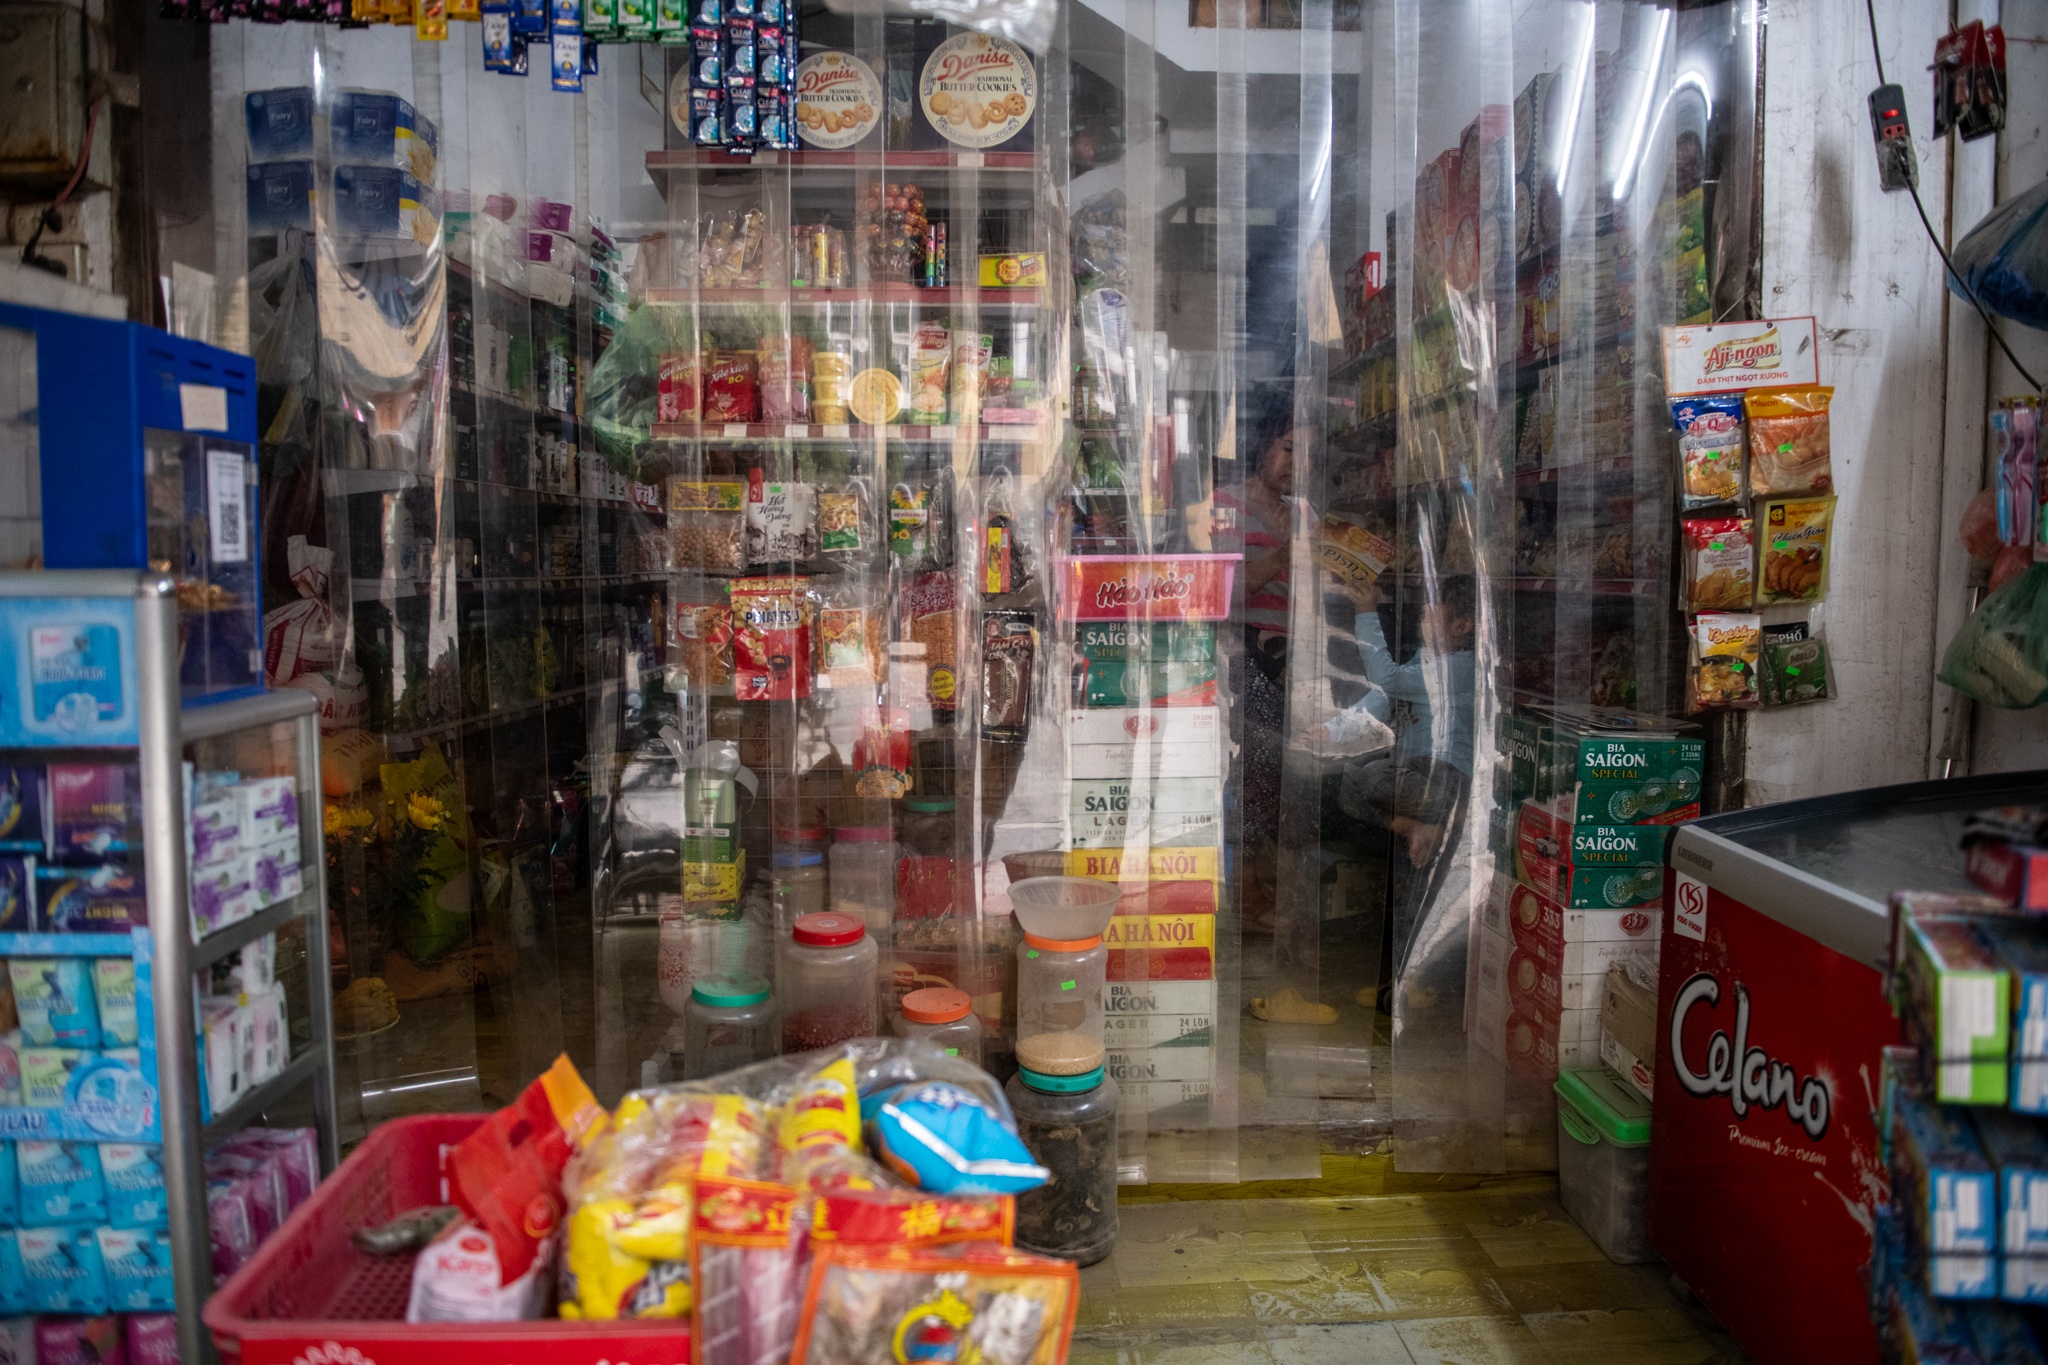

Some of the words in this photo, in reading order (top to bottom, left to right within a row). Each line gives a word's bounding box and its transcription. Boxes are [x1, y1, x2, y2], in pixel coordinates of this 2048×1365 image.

[484, 21, 507, 31] Dove
[730, 27, 752, 35] CLEAR
[555, 40, 579, 51] Dove
[936, 48, 1014, 81] Danisa
[798, 65, 862, 93] Danisa
[940, 82, 975, 92] BUTTER
[976, 81, 1017, 92] COOKIES
[801, 94, 831, 102] BUTTER
[831, 94, 865, 102] COOKIES
[271, 112, 292, 121] Fairy
[356, 117, 378, 126] Fairy
[267, 185, 290, 195] Fairy
[358, 189, 381, 199] Fairy
[1704, 342, 1776, 370] Aji-ngon
[672, 370, 693, 382] HEO
[728, 374, 744, 385] BÒ
[1717, 376, 1734, 385] THỊT
[1736, 374, 1758, 383] NGỌT
[1759, 371, 1789, 381] XƯƠNG
[1096, 577, 1142, 608] Hảo
[1144, 571, 1189, 600] Hảo
[911, 594, 948, 607] Bento
[1109, 622, 1132, 632] BIA
[1086, 632, 1151, 646] SAIGON
[1778, 629, 1803, 643] PHỐ
[1607, 743, 1626, 753] BIA
[1104, 749, 1126, 760] Triple
[1585, 753, 1646, 767] SAIGON
[1591, 768, 1639, 779] SPECIAL
[1109, 785, 1130, 795] BIA
[1084, 796, 1156, 811] SAIGON
[1181, 815, 1192, 824] 24
[1195, 815, 1212, 824] LON
[1597, 827, 1616, 837] BIA
[1575, 836, 1637, 851] SAIGON
[1581, 852, 1630, 863] SPECIAL
[1086, 856, 1121, 876] BIA
[1160, 850, 1197, 878] NỘI
[1542, 906, 1561, 930] 333
[1625, 912, 1644, 927] 333
[1124, 916, 1155, 942] HÀ
[1158, 917, 1195, 945] NỘI
[1110, 986, 1132, 995] BIA
[1541, 973, 1558, 997] 333
[1104, 1019, 1149, 1029] AGER
[1179, 1017, 1190, 1027] 24
[1193, 1017, 1209, 1026] LON
[1109, 1054, 1131, 1064] BIA
[1670, 971, 1831, 1141] Celano
[1181, 1084, 1191, 1093] 24
[1728, 1124, 1771, 1151] Premium
